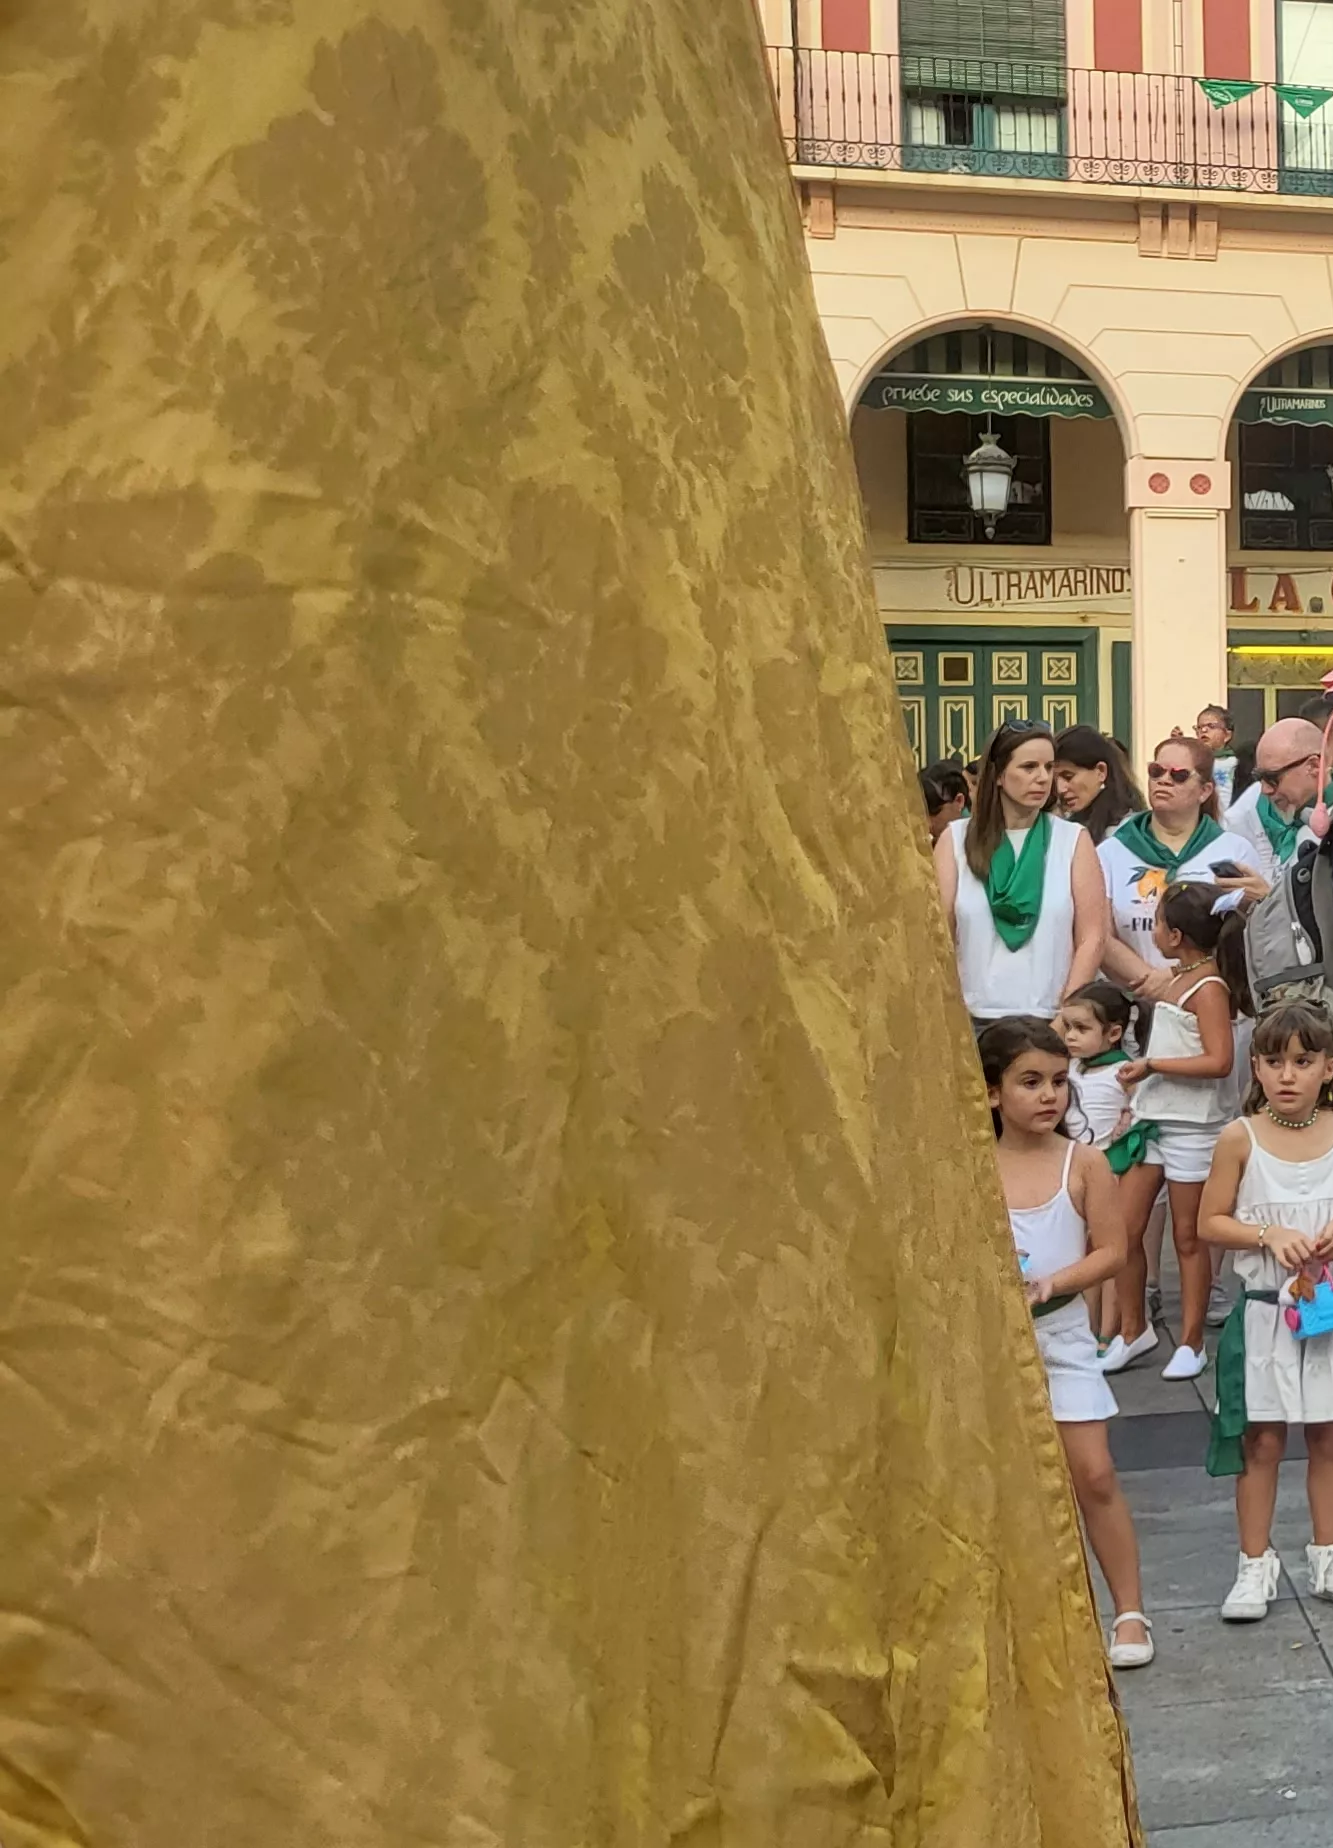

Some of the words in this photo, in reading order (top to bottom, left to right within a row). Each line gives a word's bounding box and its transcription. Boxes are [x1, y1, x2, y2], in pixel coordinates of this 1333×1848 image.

[881, 384, 941, 405] pruebe
[947, 388, 973, 403] sus
[981, 386, 1094, 410] especialidades
[1230, 567, 1302, 613] LA
